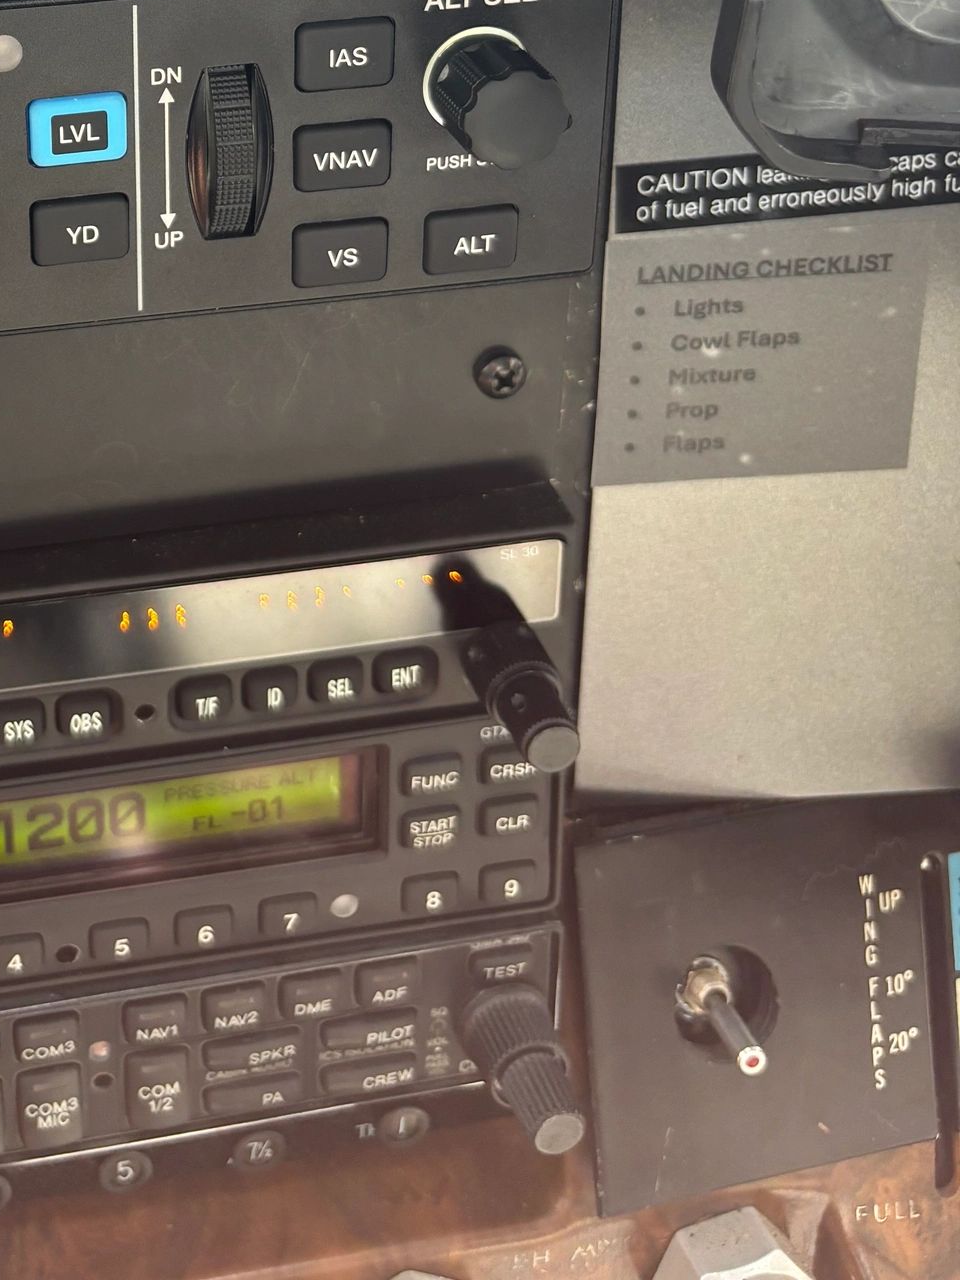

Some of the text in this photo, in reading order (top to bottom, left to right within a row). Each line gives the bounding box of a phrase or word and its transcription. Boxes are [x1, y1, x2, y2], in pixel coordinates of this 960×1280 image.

[328, 46, 369, 69] IAS
[150, 66, 183, 87] DN
[58, 123, 101, 145] LVL
[313, 147, 379, 172] VNAV
[426, 154, 473, 172] PUSH
[636, 166, 750, 197] CAUTION
[636, 177, 937, 222] of fuel and erroneously high
[65, 224, 100, 245] YD
[153, 230, 185, 250] UP
[453, 234, 496, 256] ALT
[327, 247, 359, 269] VS
[636, 252, 894, 285] LANDING CHECKLIST
[673, 298, 745, 319] Lights
[669, 329, 801, 353] Cowl Flaps
[668, 366, 757, 387] Mixture
[665, 402, 719, 422] Prop
[662, 434, 726, 454] Flaps
[391, 664, 422, 688] ENT
[327, 677, 355, 698] SEL
[3, 719, 35, 742] SYS
[70, 710, 103, 733] OBS
[278, 765, 320, 788] ALT
[410, 771, 461, 791] FUNC
[409, 816, 458, 834] START
[495, 814, 531, 832] CLR
[412, 832, 456, 850] STOP
[878, 888, 903, 913] UP
[483, 962, 528, 980] TEST
[371, 986, 409, 1004] ADF
[294, 998, 333, 1017] DME
[213, 1010, 260, 1029] NAV2
[135, 1024, 179, 1041] NAV1
[366, 1024, 415, 1046] PILOT
[21, 1040, 76, 1061] COM3
[248, 1045, 297, 1066] SPKR
[362, 1068, 415, 1090] CREW
[137, 1081, 181, 1101] COM
[262, 1090, 285, 1106] PA
[24, 1096, 79, 1118] COM3
[37, 1111, 71, 1130] MIC
[855, 1199, 921, 1224] FULL
